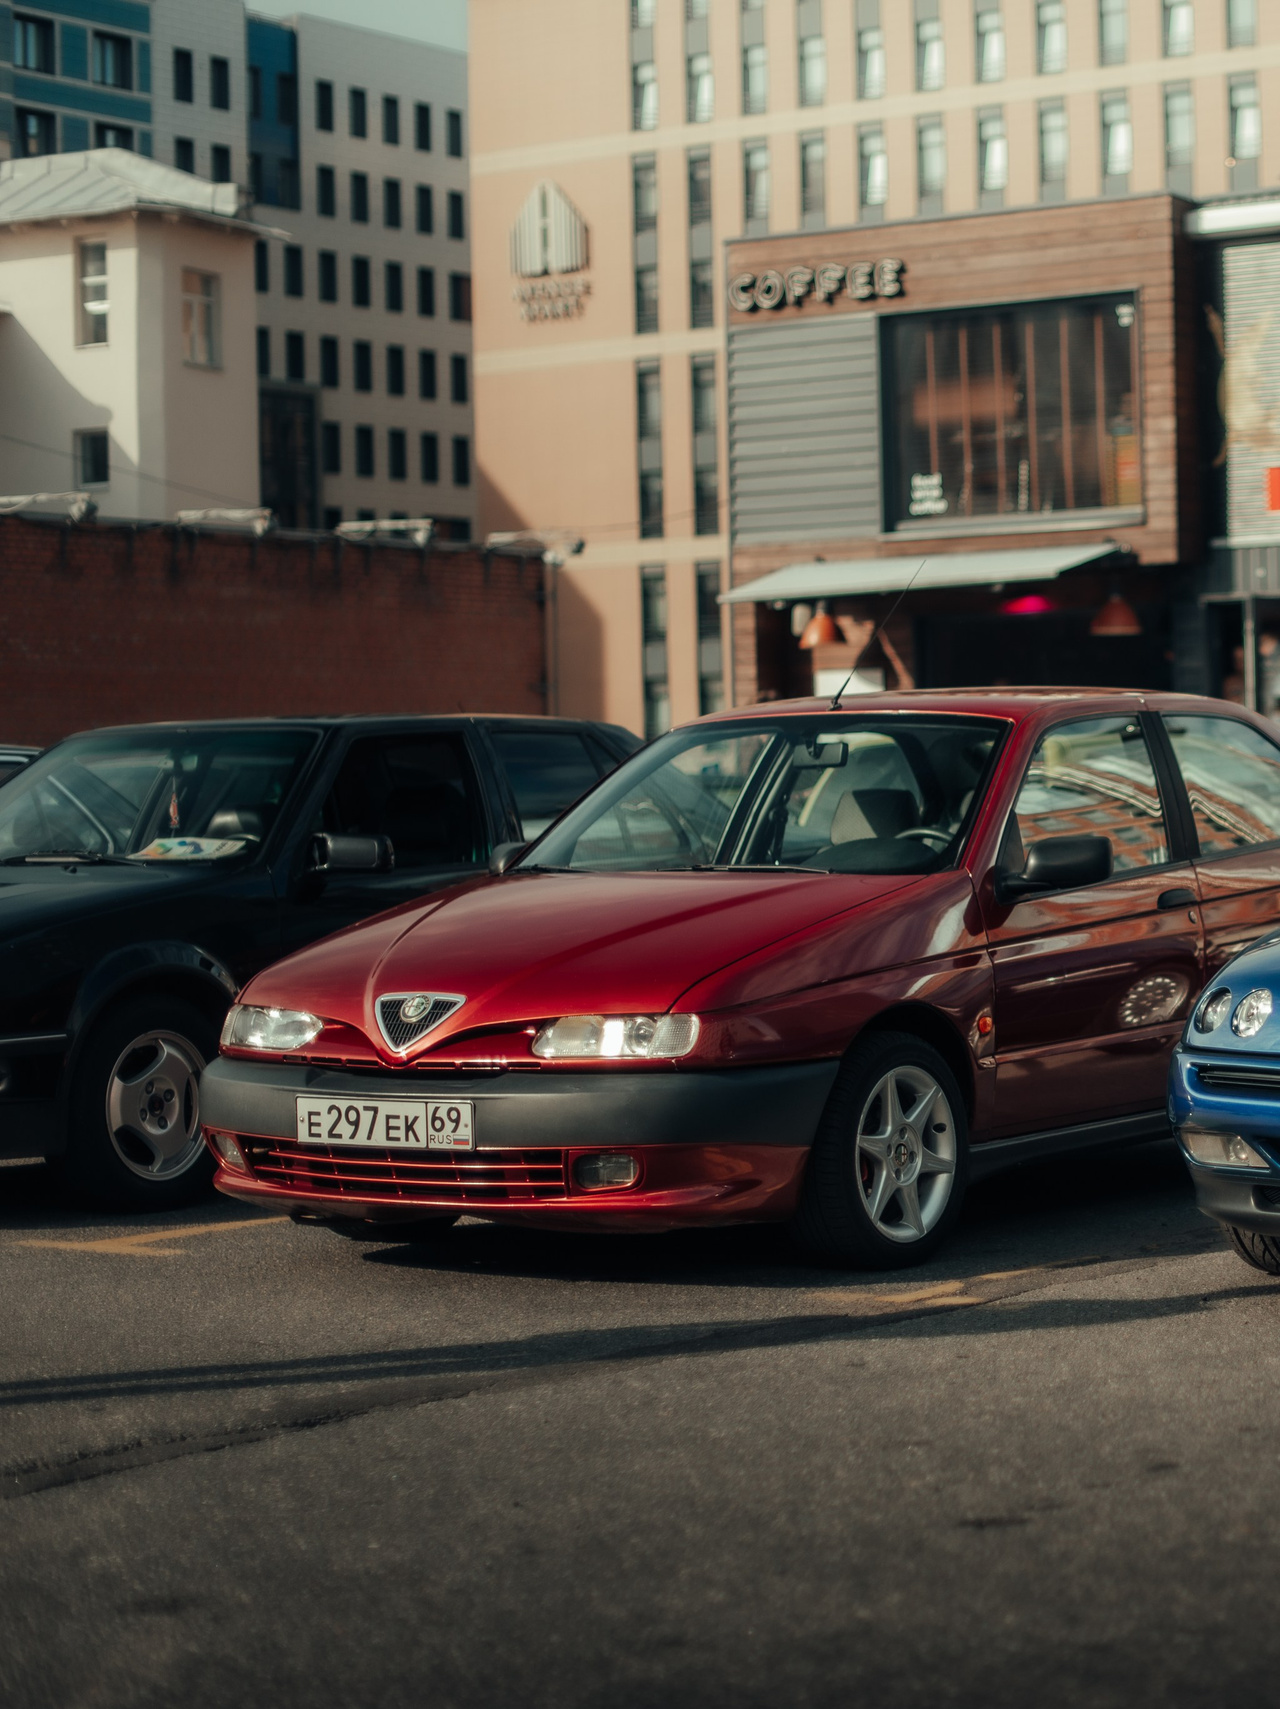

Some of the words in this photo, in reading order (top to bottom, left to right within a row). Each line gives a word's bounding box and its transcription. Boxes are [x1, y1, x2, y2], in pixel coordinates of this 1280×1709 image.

[728, 257, 903, 312] COFFEE
[307, 1104, 421, 1143] E297EK
[430, 1106, 461, 1134] 69
[429, 1134, 452, 1144] RUS
